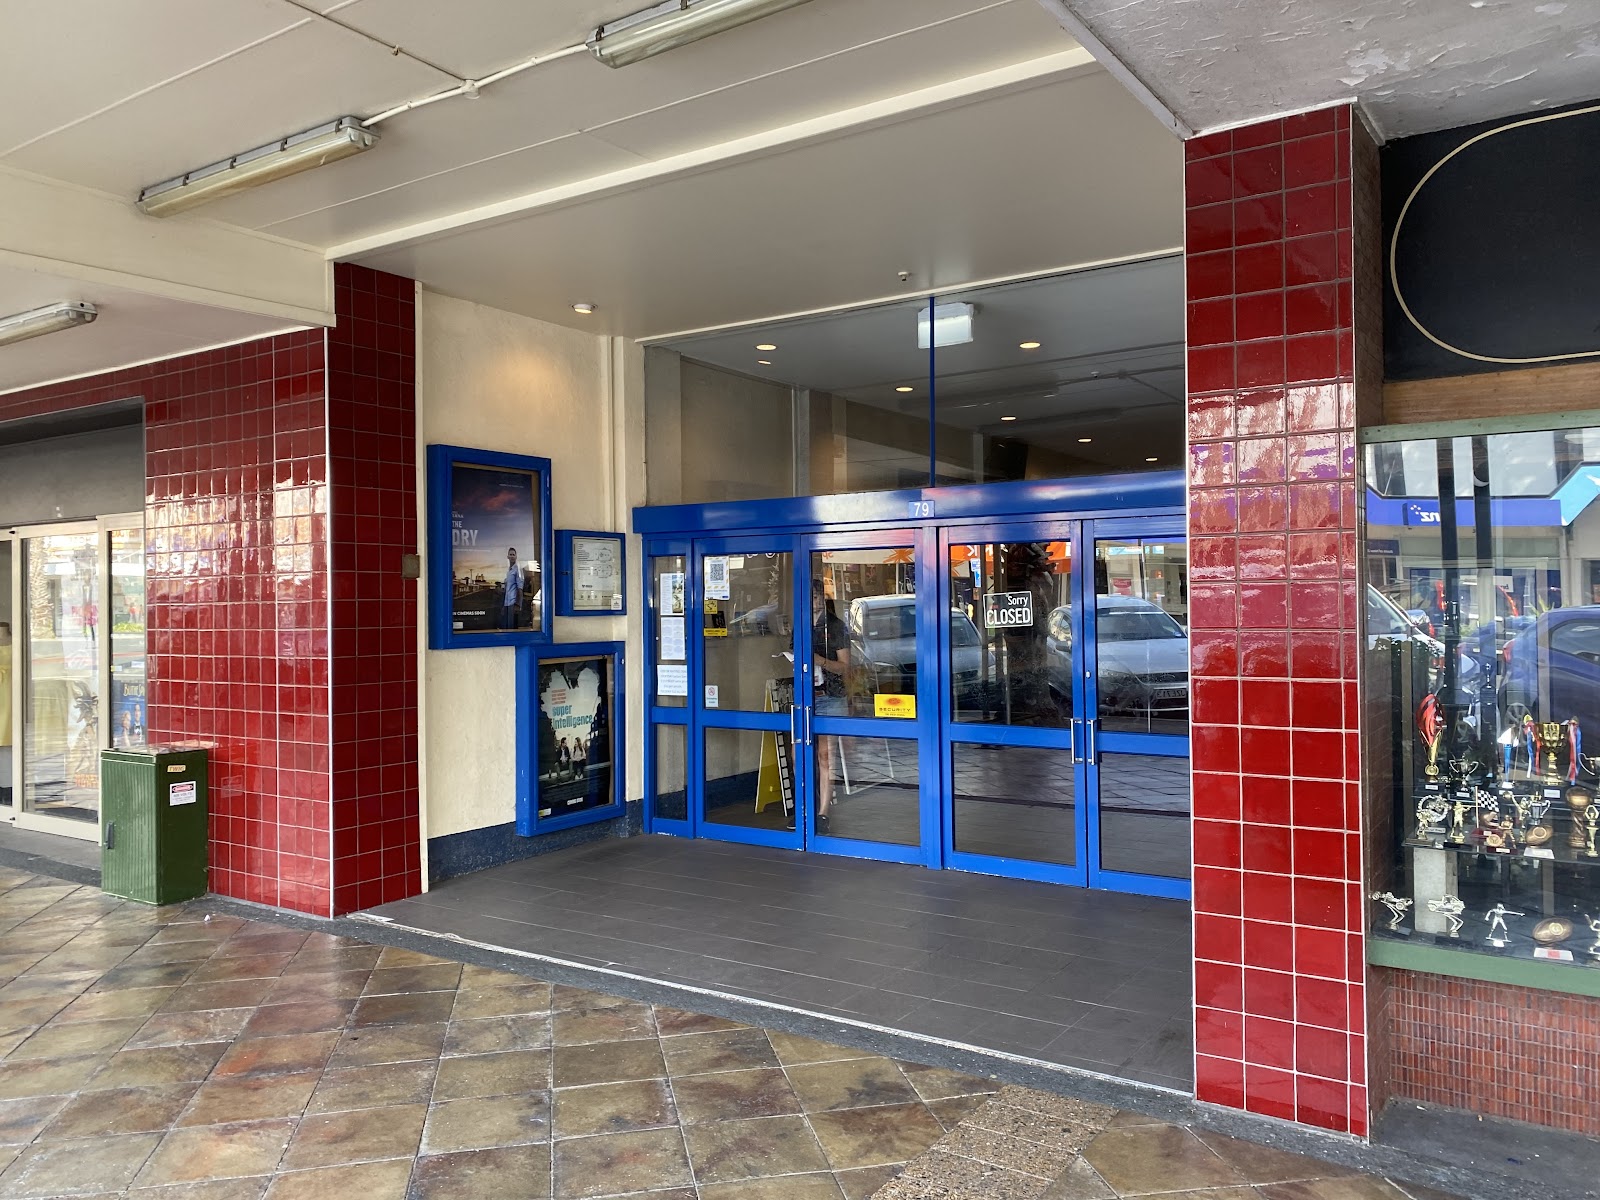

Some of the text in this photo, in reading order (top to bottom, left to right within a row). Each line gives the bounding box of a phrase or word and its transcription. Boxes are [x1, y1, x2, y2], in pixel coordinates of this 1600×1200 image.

[913, 502, 930, 517] 79
[452, 520, 463, 528] THE
[452, 528, 479, 547] DRY
[1007, 595, 1029, 607] Sorry
[986, 607, 1031, 626] CLOSED
[552, 704, 573, 718] super
[552, 714, 593, 730] intelligence
